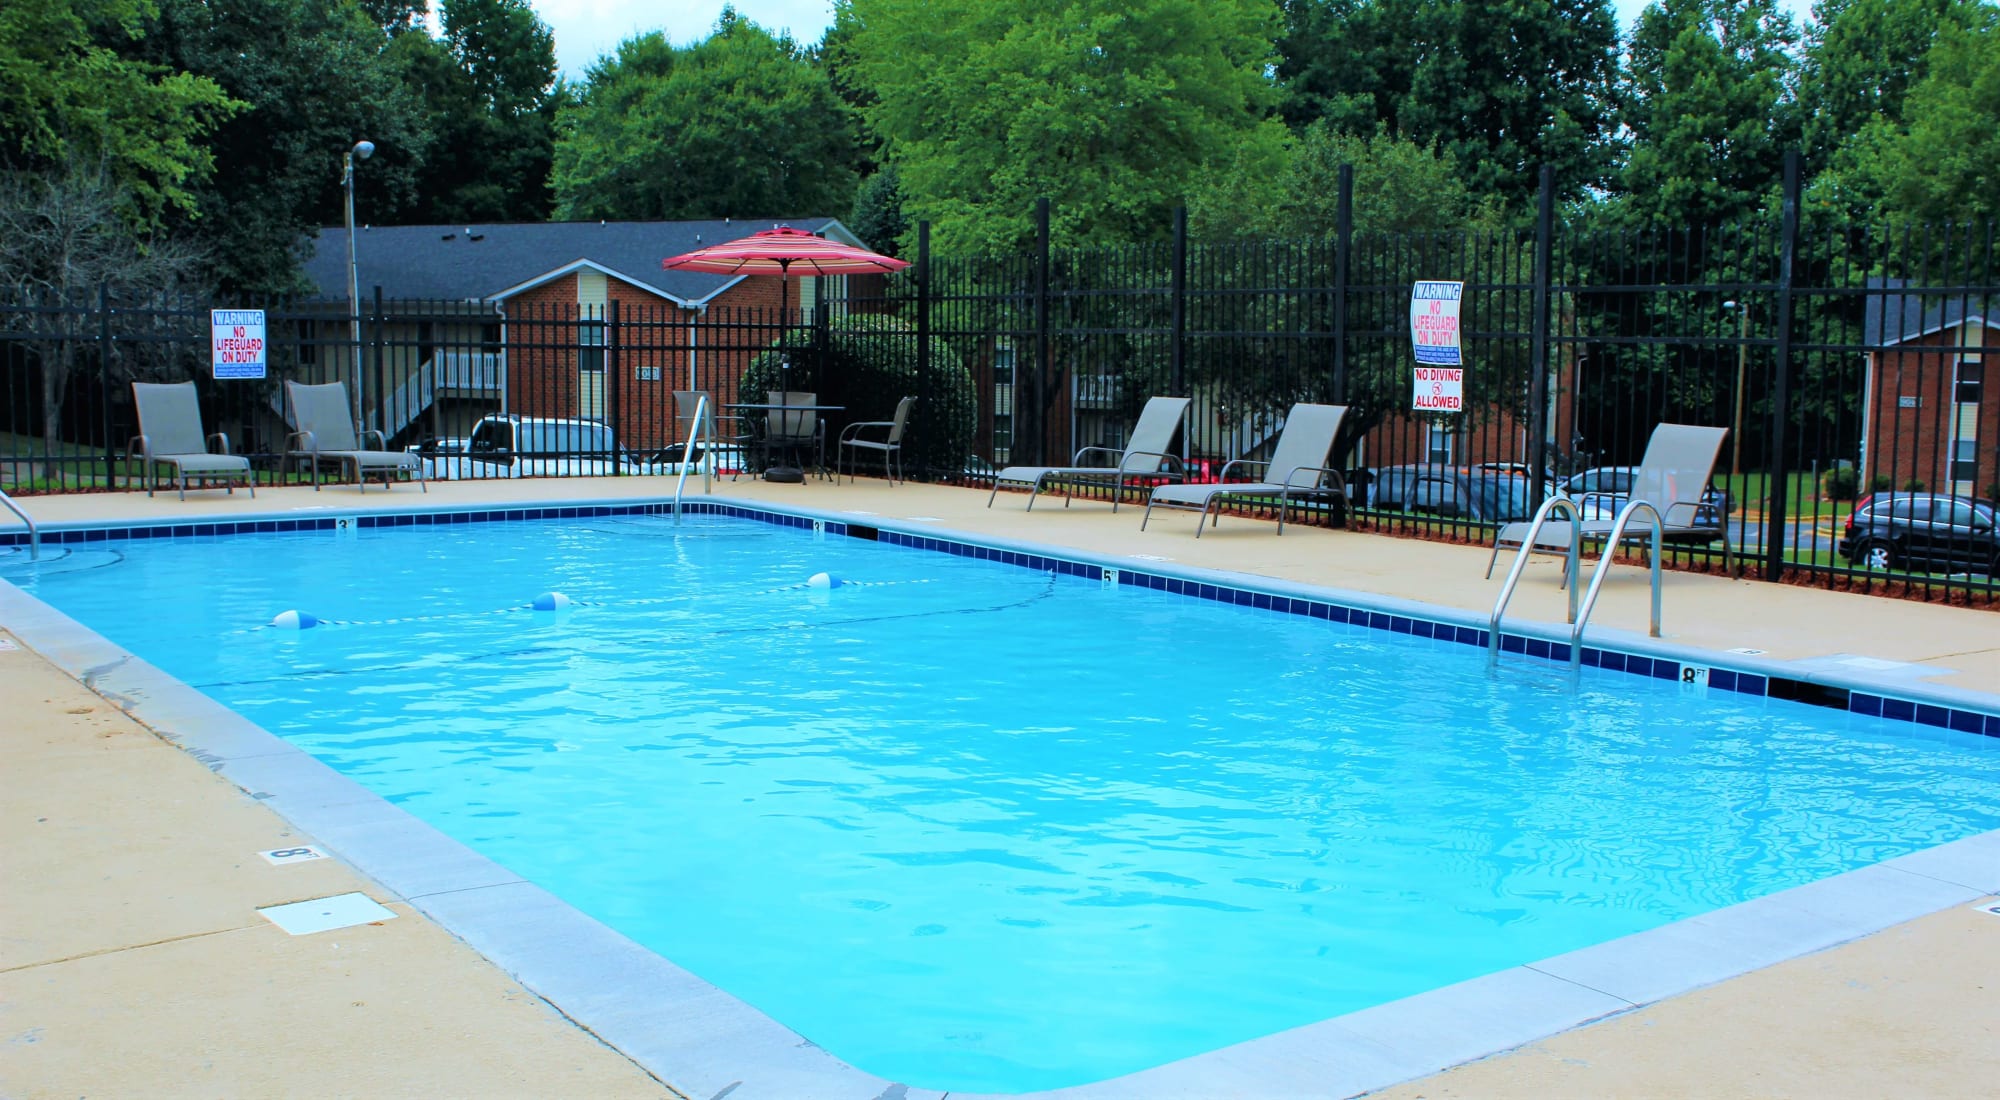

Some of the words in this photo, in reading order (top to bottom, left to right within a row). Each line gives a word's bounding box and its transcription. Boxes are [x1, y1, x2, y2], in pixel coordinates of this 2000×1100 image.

[1416, 284, 1460, 300] WARNING
[1430, 300, 1441, 314] NO
[214, 312, 262, 325] WARNING
[1414, 315, 1456, 331] LIFEGUARD
[233, 326, 245, 338] NO
[1418, 331, 1428, 344] ON
[1432, 331, 1452, 345] DUTY
[217, 339, 262, 350] LIFEGUARD
[222, 352, 233, 363] ON
[236, 352, 257, 363] DUTY
[1416, 369, 1428, 380] NO
[1431, 370, 1461, 382] DIVING
[1416, 395, 1459, 409] ALLOWED
[1103, 569, 1111, 582] 5
[1683, 667, 1695, 683] 8
[1696, 669, 1706, 678] FT
[270, 848, 313, 858] 8
